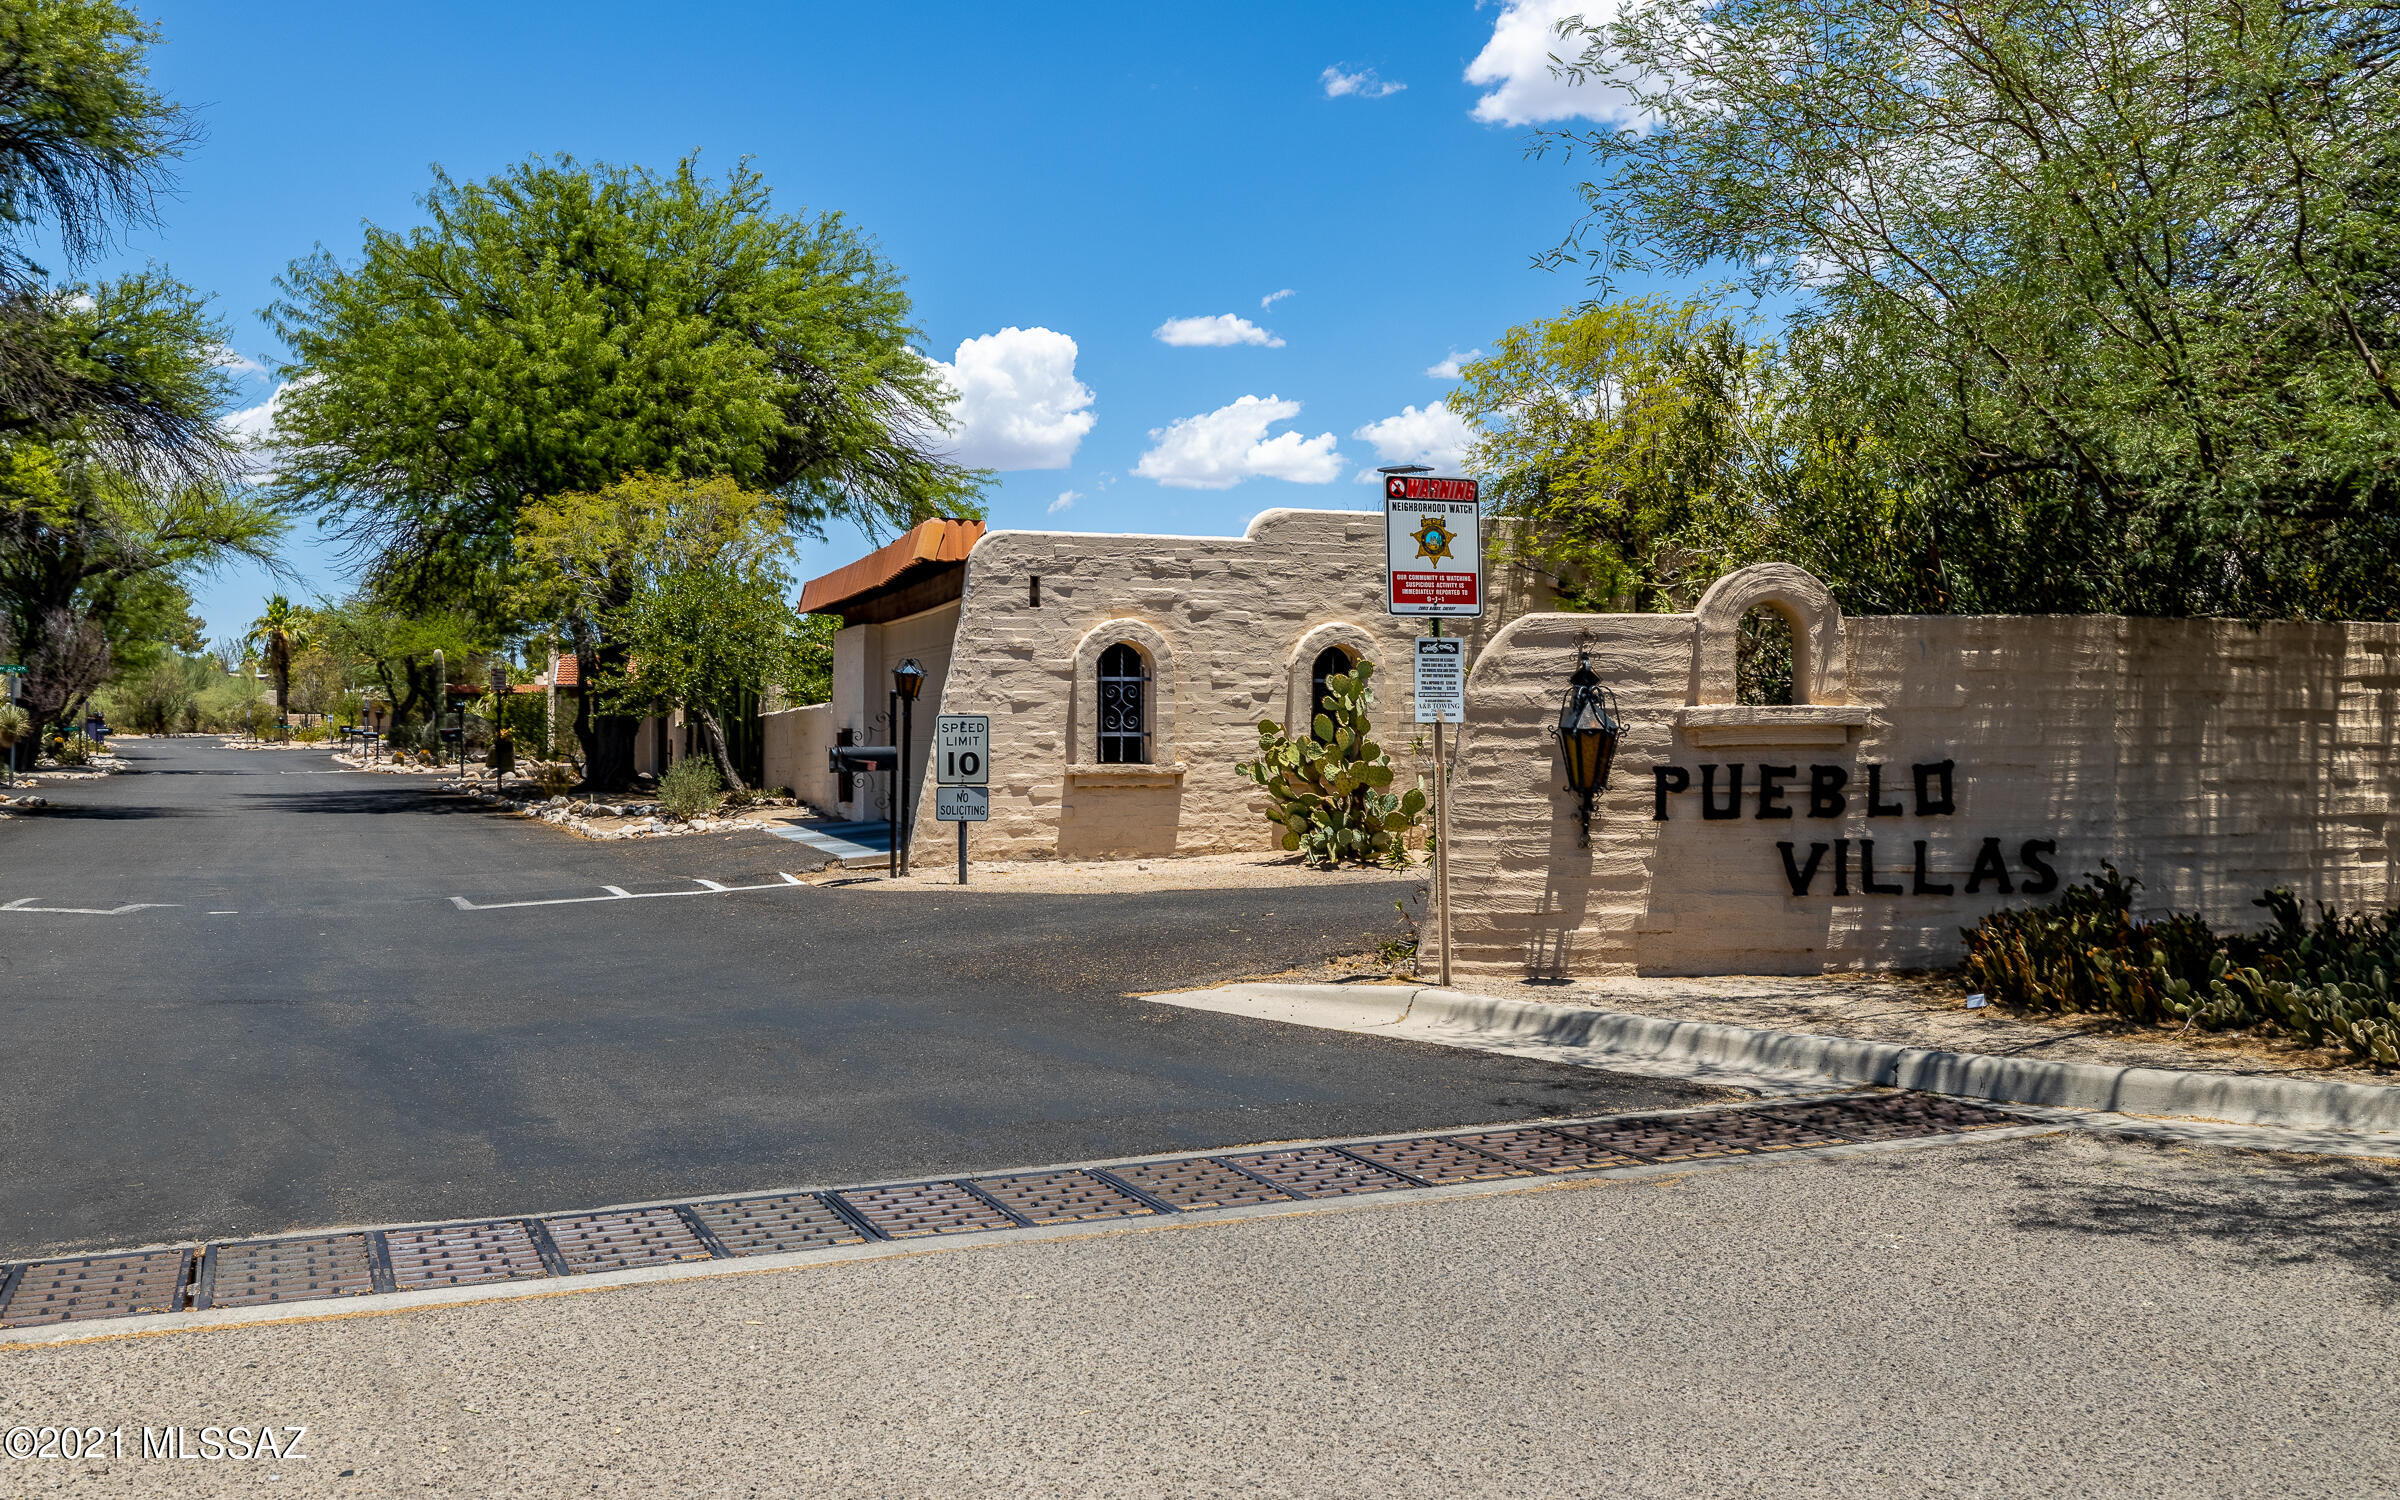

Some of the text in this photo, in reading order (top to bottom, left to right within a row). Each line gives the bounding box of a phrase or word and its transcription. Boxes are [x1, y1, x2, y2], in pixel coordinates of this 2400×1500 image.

[1406, 478, 1476, 500] WARNING
[1392, 502, 1473, 514] NEIGHBORHOOD WATCH
[942, 722, 985, 733] SPEED
[946, 736, 980, 746] LIMIT
[948, 751, 980, 776] 10
[1652, 758, 1956, 821] PUEBLO
[956, 791, 969, 803] NO
[940, 805, 985, 816] SOLICITING
[1776, 837, 2059, 896] VILLAS
